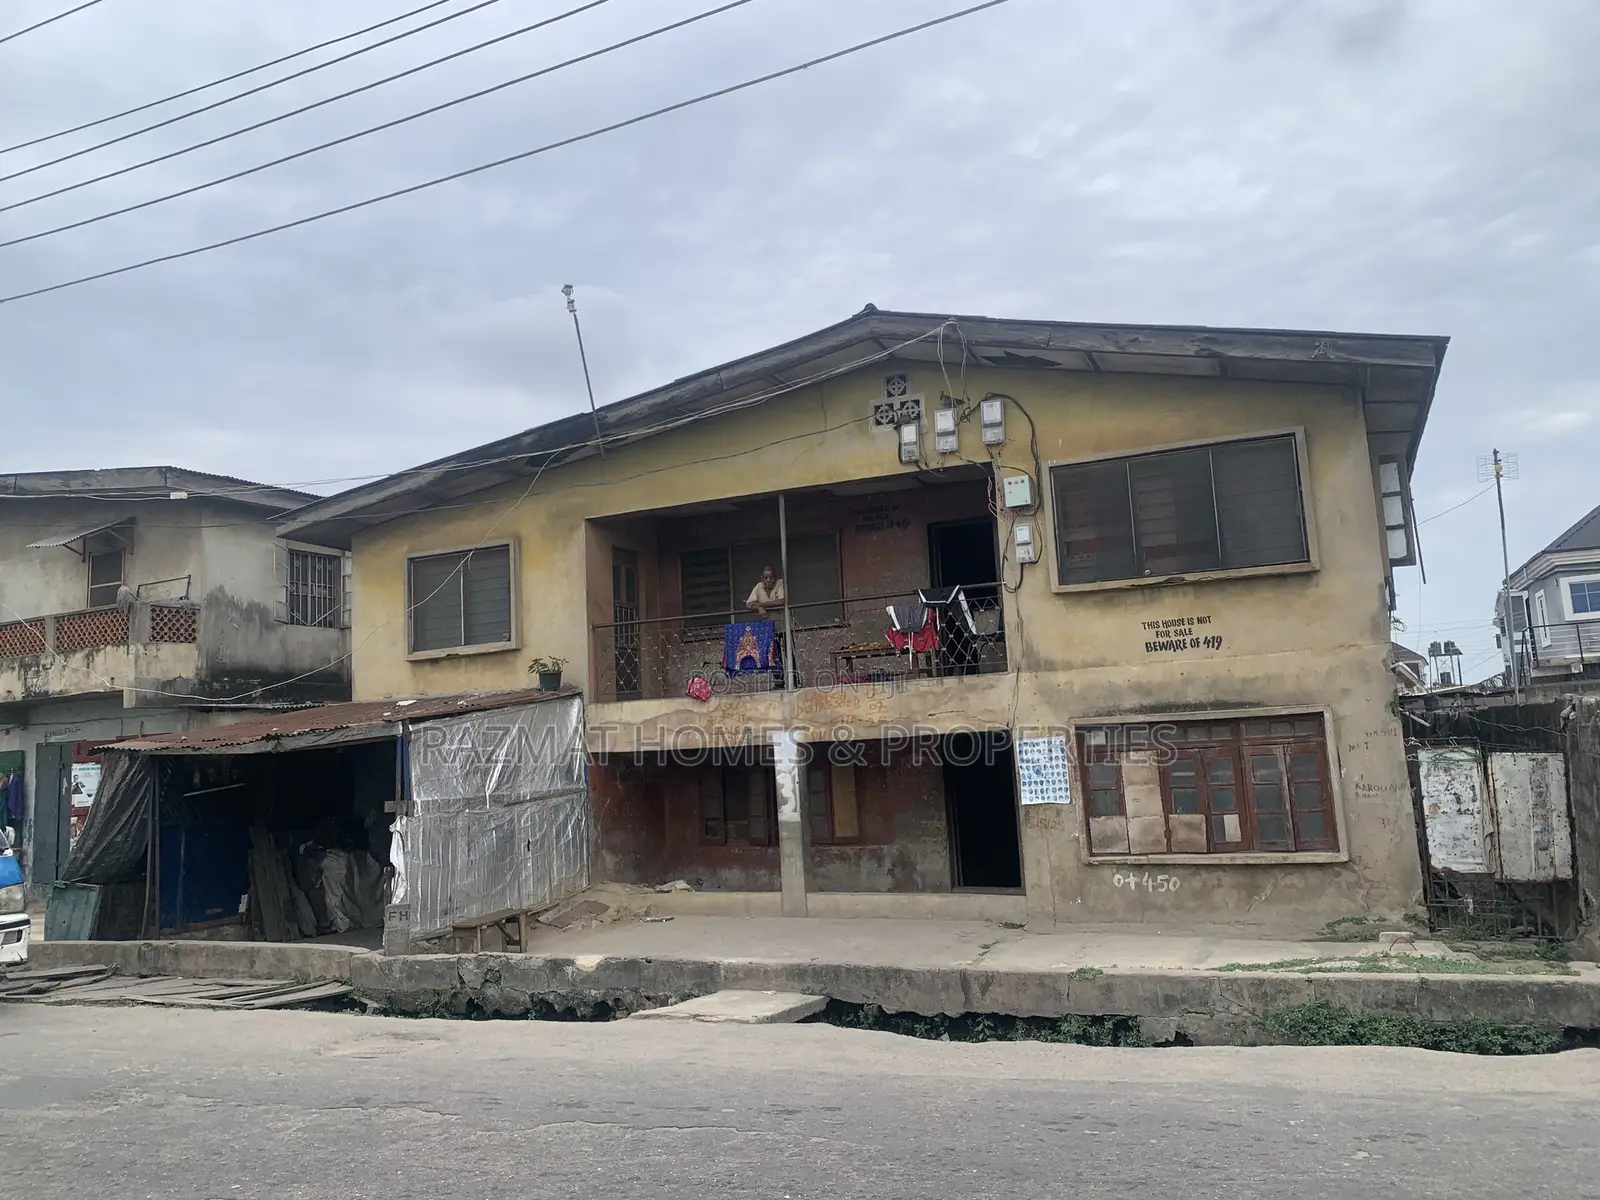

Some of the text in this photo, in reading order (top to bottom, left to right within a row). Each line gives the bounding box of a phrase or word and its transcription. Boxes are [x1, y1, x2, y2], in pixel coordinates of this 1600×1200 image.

[1141, 615, 1212, 630] THIS HOUSE IS NOT
[1156, 628, 1194, 639] FOR SALE
[1145, 635, 1223, 653] BEWARE OF 419
